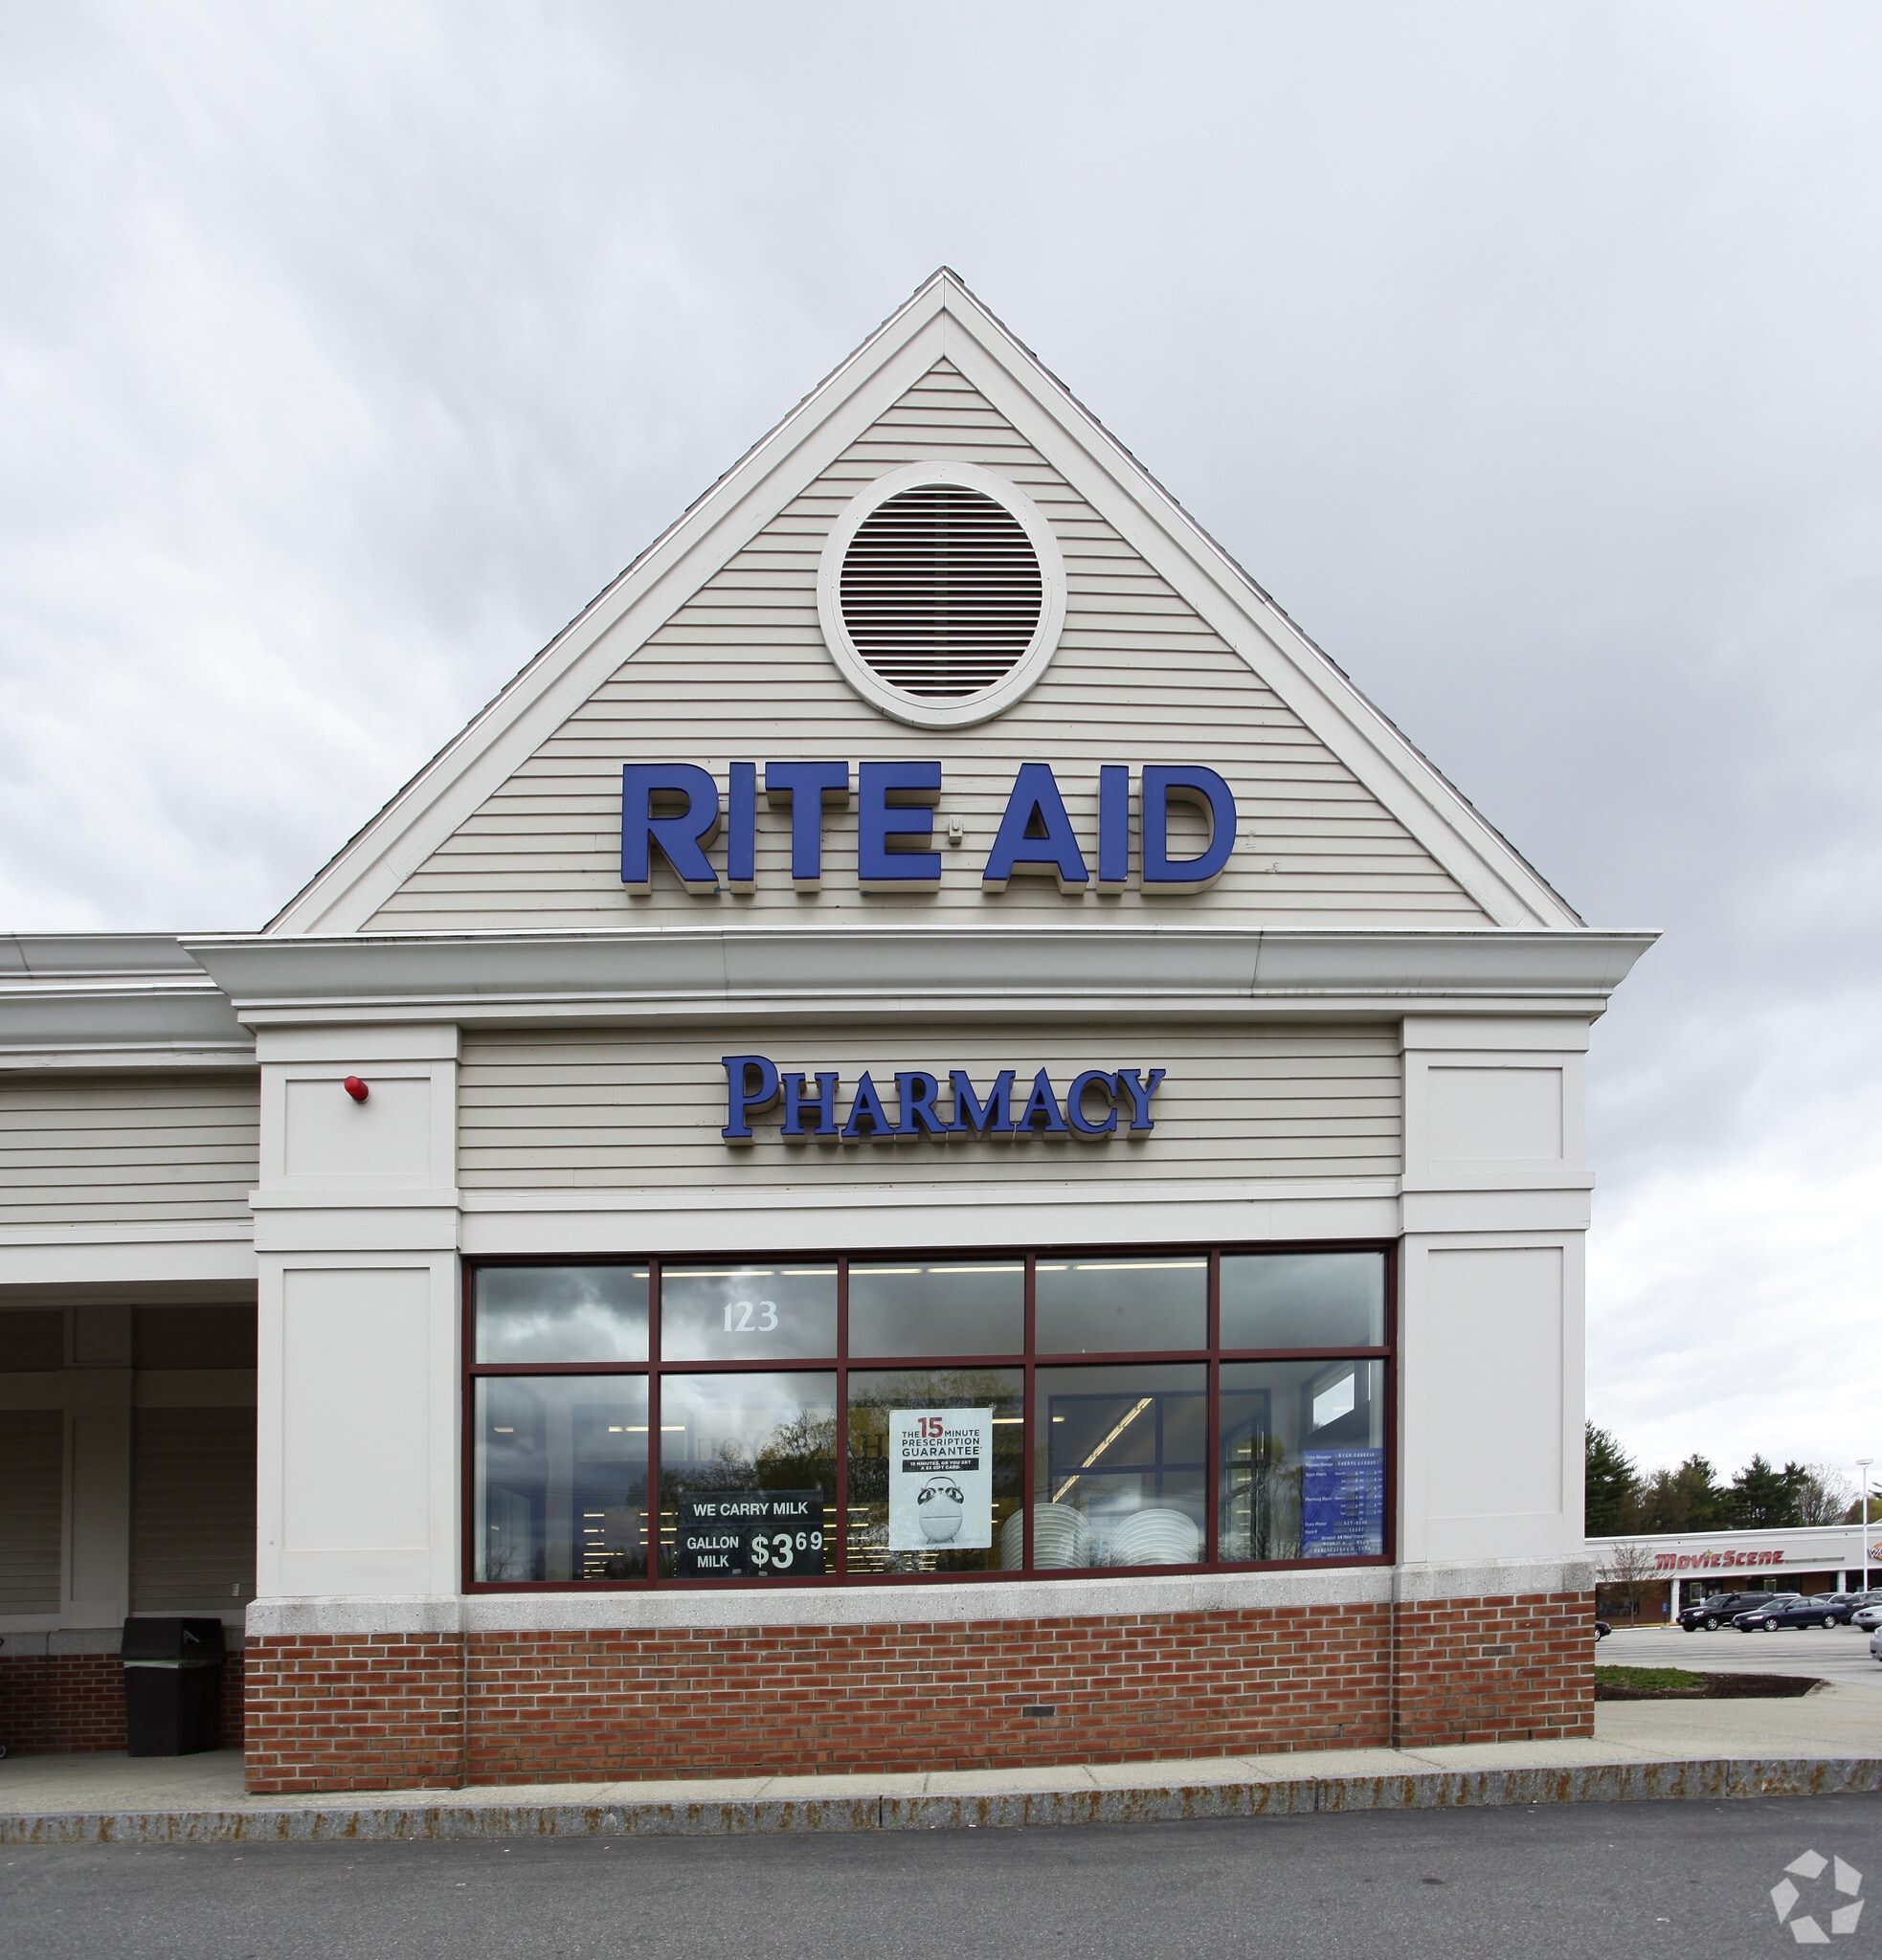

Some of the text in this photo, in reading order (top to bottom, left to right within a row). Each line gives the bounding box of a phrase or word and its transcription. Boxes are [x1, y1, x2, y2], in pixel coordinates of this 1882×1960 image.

[620, 761, 1237, 888] RITE AID
[722, 1054, 1166, 1142] PHARMACY
[723, 1301, 778, 1332] 123
[917, 1416, 944, 1438] 15
[944, 1429, 980, 1437] MINUTE
[902, 1437, 980, 1447] PRESCRIPTION
[902, 1446, 980, 1457] GUARANTEE
[693, 1502, 809, 1517] WE CARRY MILK
[686, 1536, 739, 1549] GALLON
[697, 1555, 729, 1568] MILK
